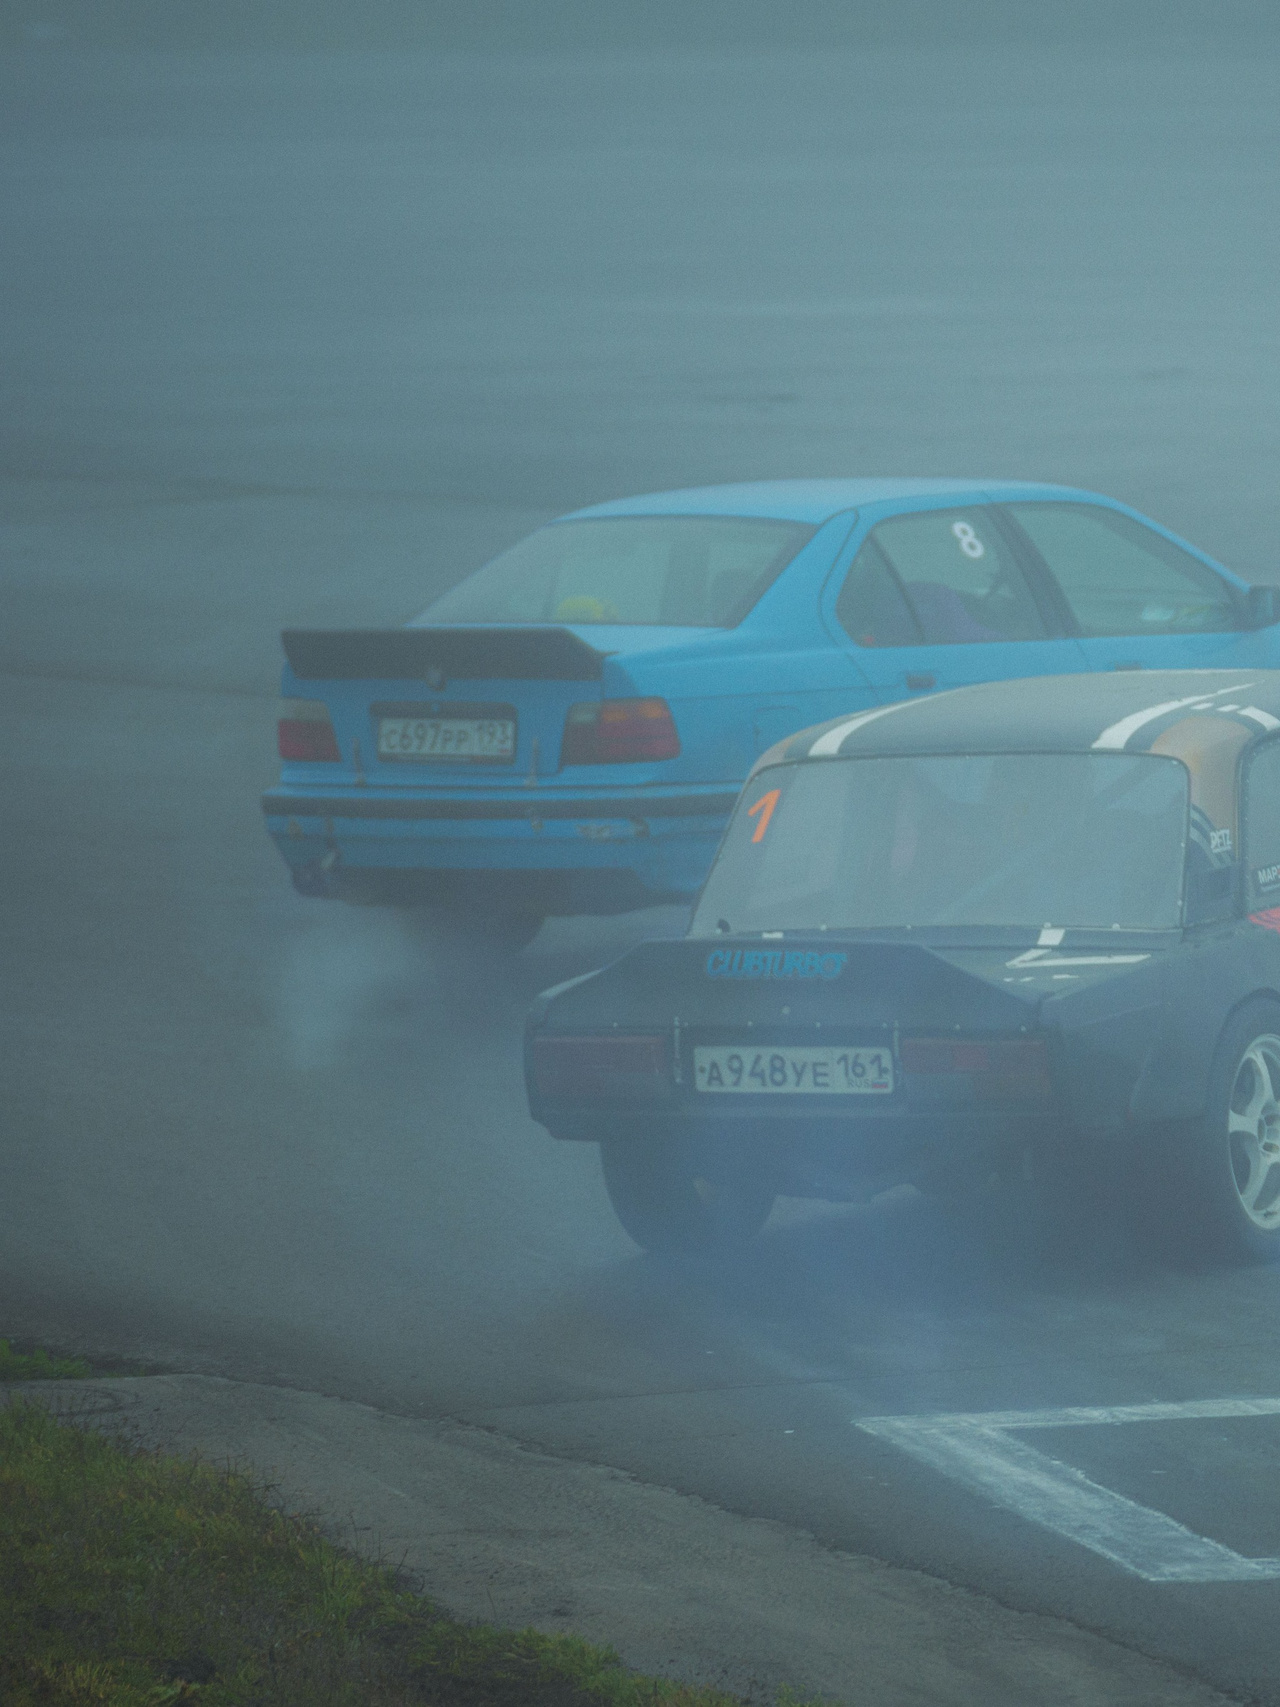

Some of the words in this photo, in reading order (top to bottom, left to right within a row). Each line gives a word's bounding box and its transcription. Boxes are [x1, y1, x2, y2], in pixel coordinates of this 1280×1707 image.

[952, 521, 984, 558] 8
[747, 788, 782, 844] 1
[706, 949, 849, 980] CLUBTURBO
[705, 1053, 830, 1088] А948УЕ
[835, 1052, 884, 1080] 161
